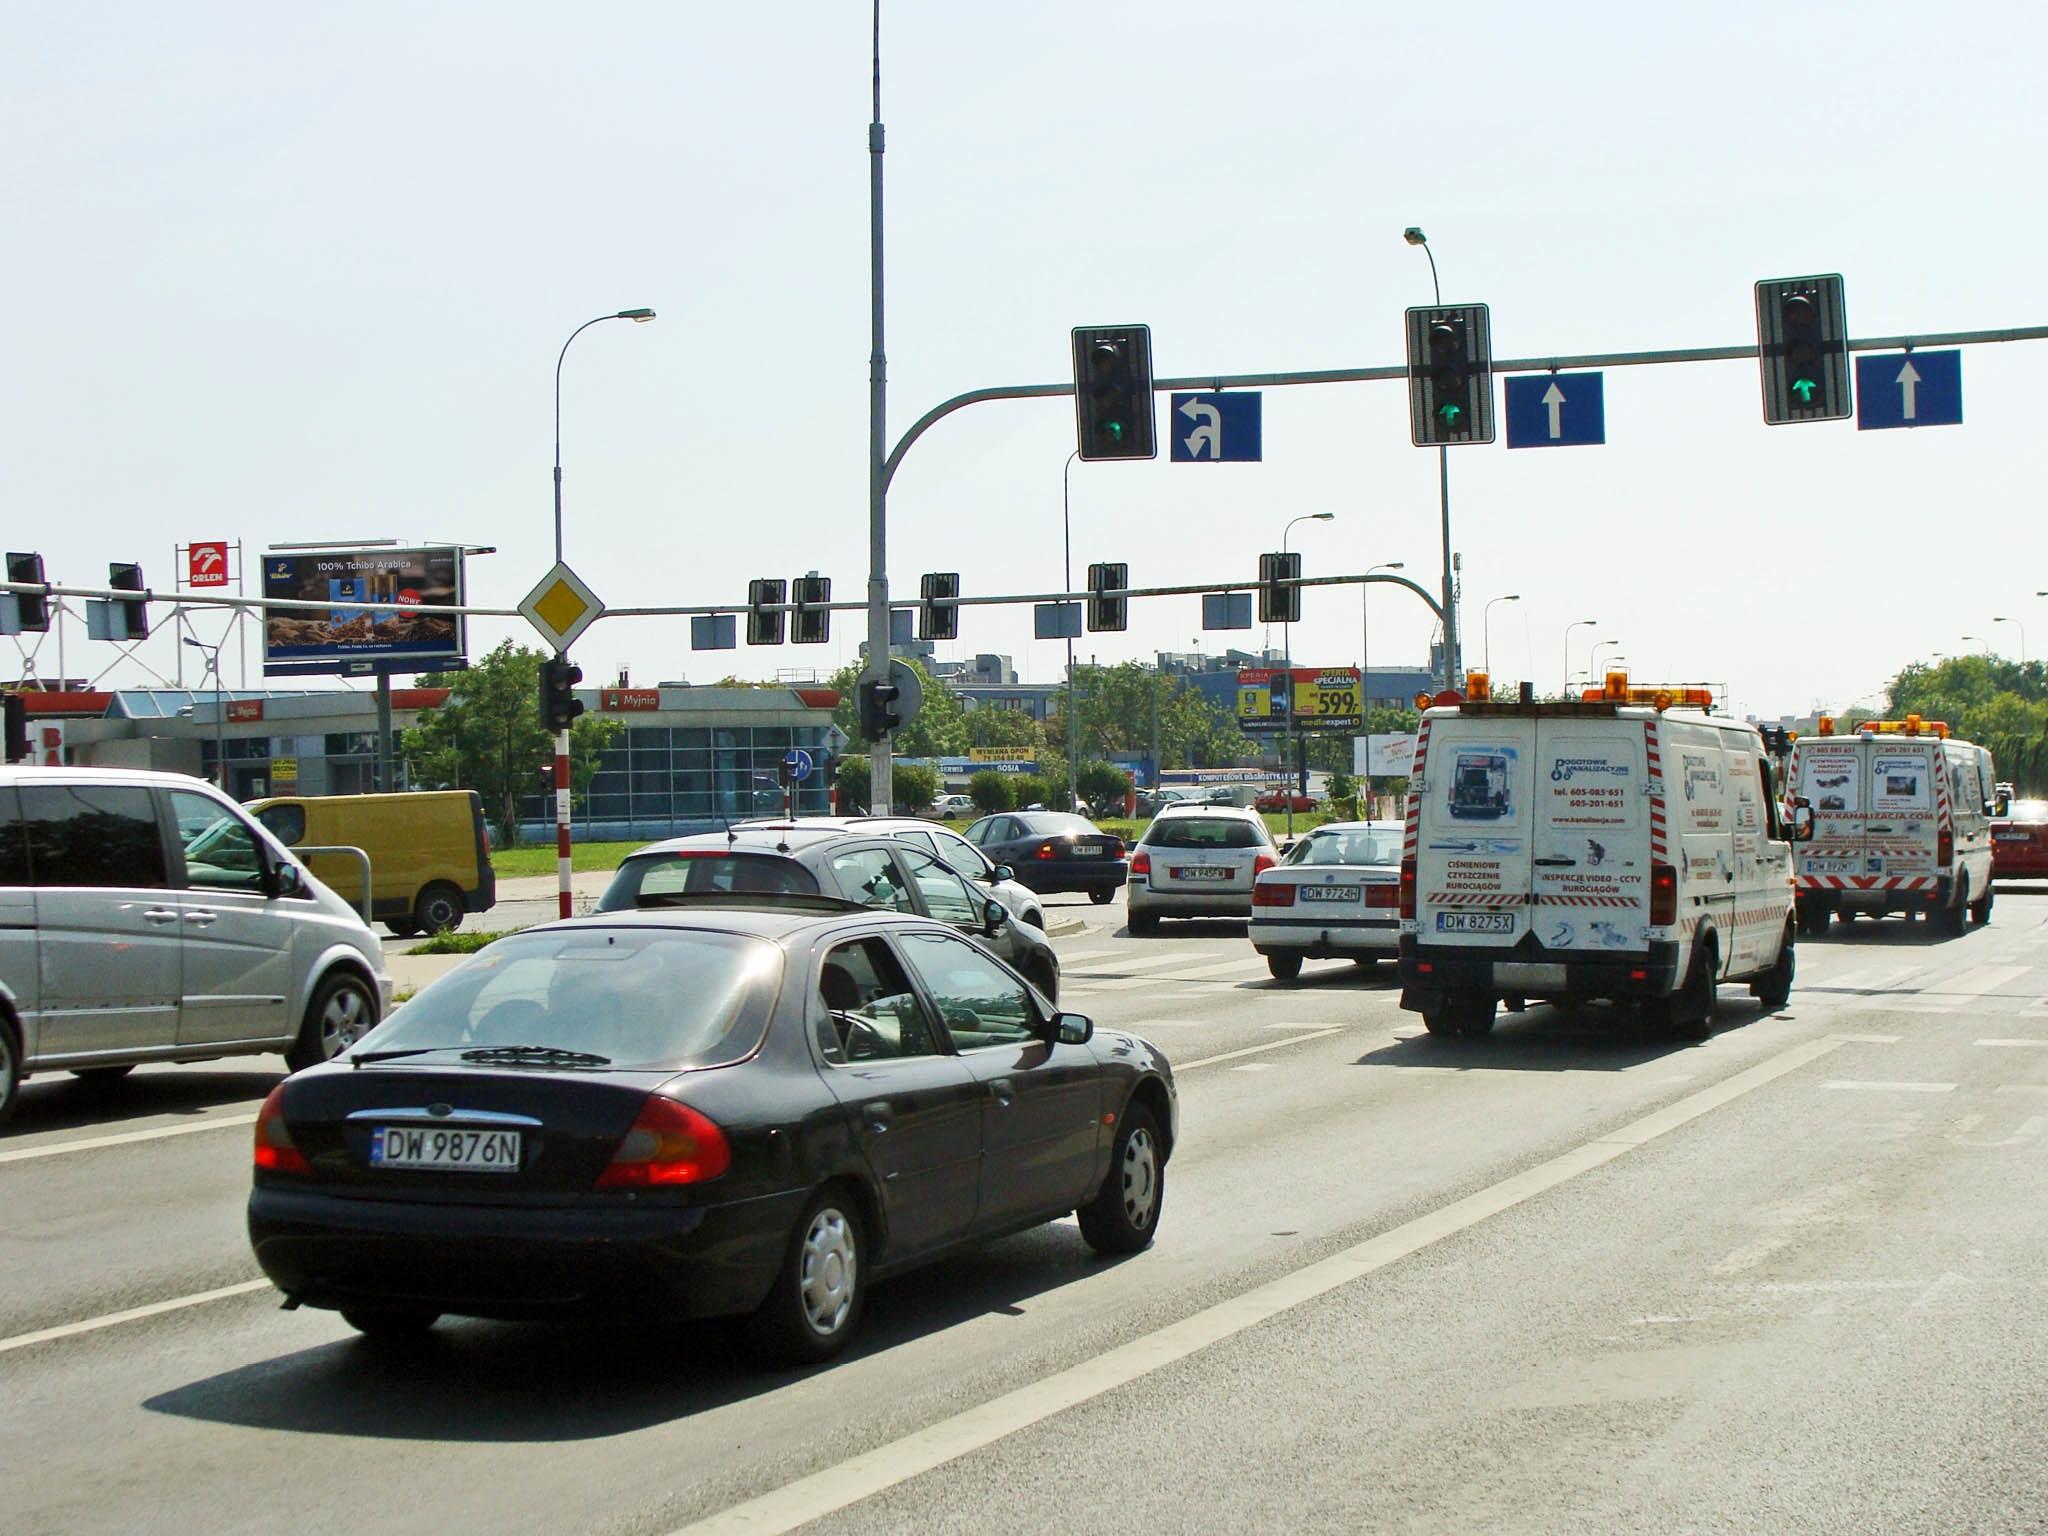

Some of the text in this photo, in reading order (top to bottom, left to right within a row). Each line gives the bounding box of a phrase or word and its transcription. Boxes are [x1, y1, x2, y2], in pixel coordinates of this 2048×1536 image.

[317, 560, 411, 571] 100% Tchibo Arabica
[192, 573, 223, 582] ORLEN
[1240, 671, 1269, 680] XPERIA
[1313, 676, 1358, 685] SPECJALNA
[624, 695, 656, 707] Myjnia
[1555, 759, 1607, 769] POGOTOWIE
[1565, 766, 1629, 774] KANALIZACYJNE
[1570, 800, 1624, 808] 605-201-651
[1448, 861, 1500, 869] CIŚNIENIOWE
[1448, 872, 1500, 880] CZYSZCZENIE
[1446, 883, 1501, 891] RUROCIĄGÓW
[1562, 885, 1620, 894] RUROCIĄGÓW
[1307, 887, 1357, 899] DW 9724H
[1446, 915, 1510, 929] DW 8275X
[387, 1131, 516, 1163] DW 9876N
